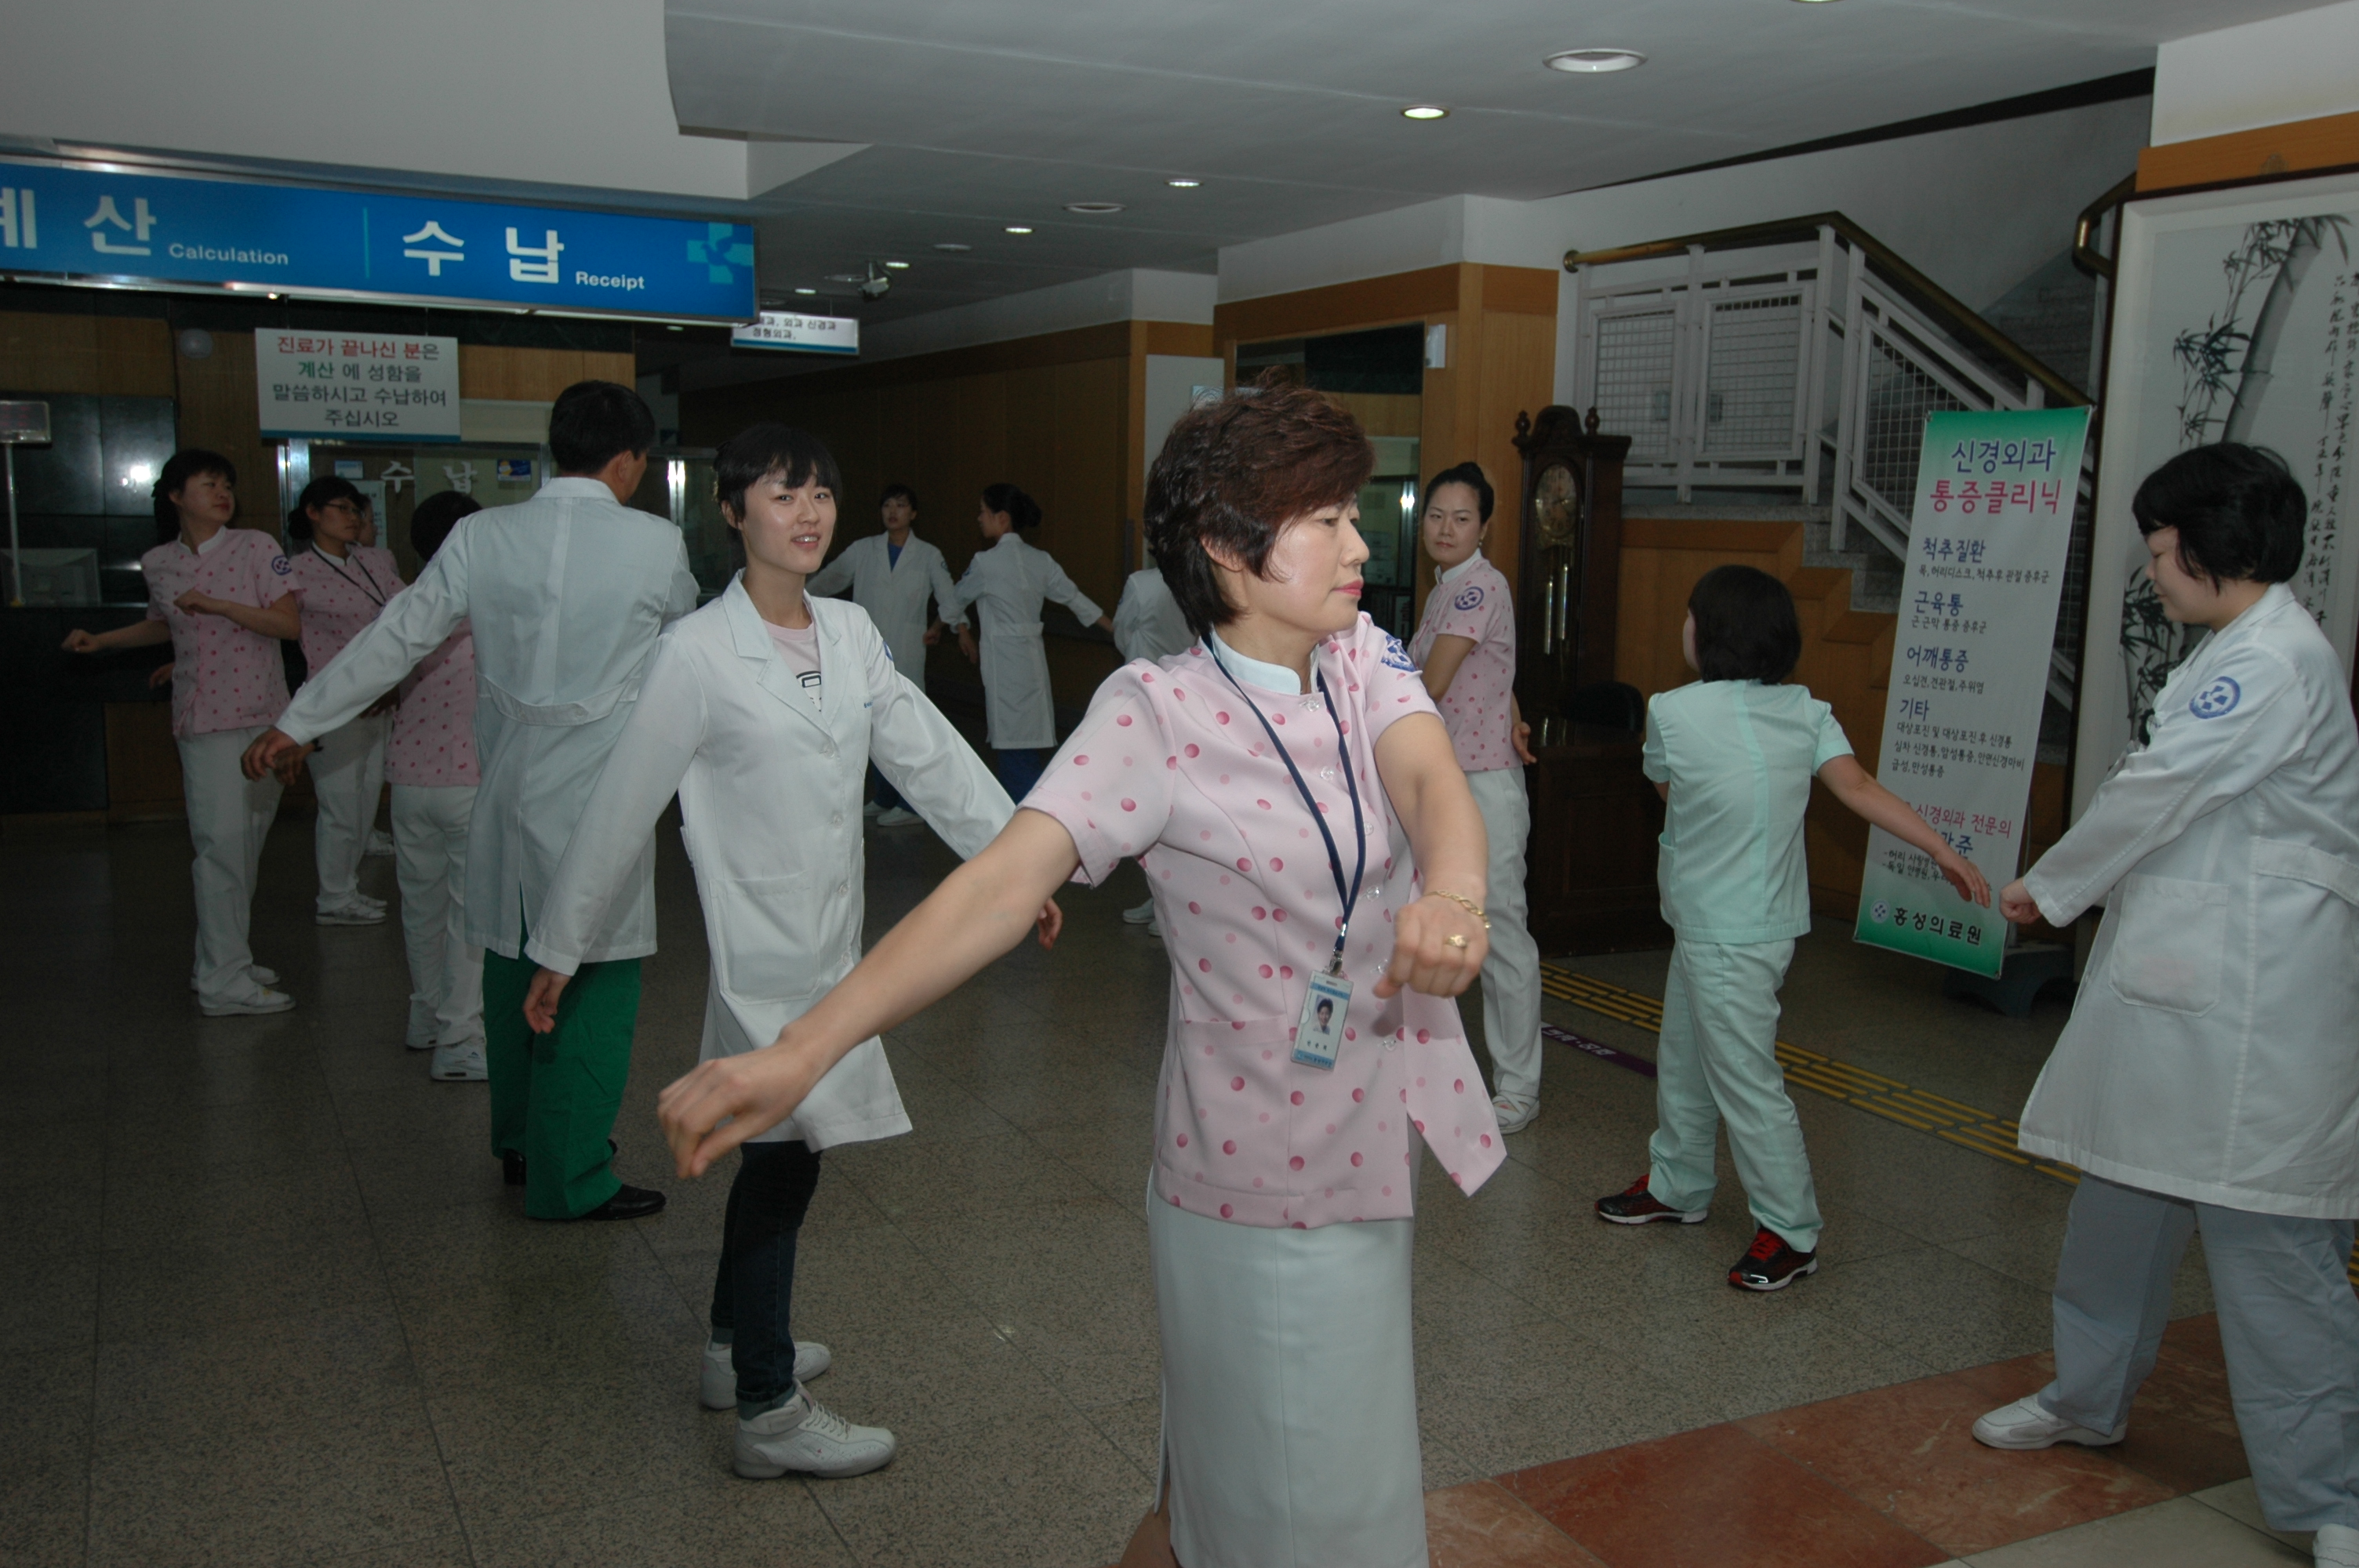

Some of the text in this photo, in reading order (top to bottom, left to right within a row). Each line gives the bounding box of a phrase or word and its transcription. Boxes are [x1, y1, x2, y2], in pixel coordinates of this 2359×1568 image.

[168, 242, 289, 266] Calculation
[575, 270, 645, 291] Receipt
[278, 336, 440, 361] 진료가 끝나신 분은
[297, 361, 422, 383] 계산 에 성함을
[272, 383, 447, 407] 말씀하시고 수납하여
[324, 408, 400, 428] 주십시오
[1950, 437, 2057, 475] 신경외과
[1929, 478, 2062, 515] 통증클리닉
[1914, 590, 1964, 617] 근육통
[1906, 644, 1970, 673] 어깨통증
[1899, 697, 1930, 722] 기타
[1916, 803, 2012, 840] 신경외과 전문의
[1892, 906, 1983, 946] 홍성의료원
